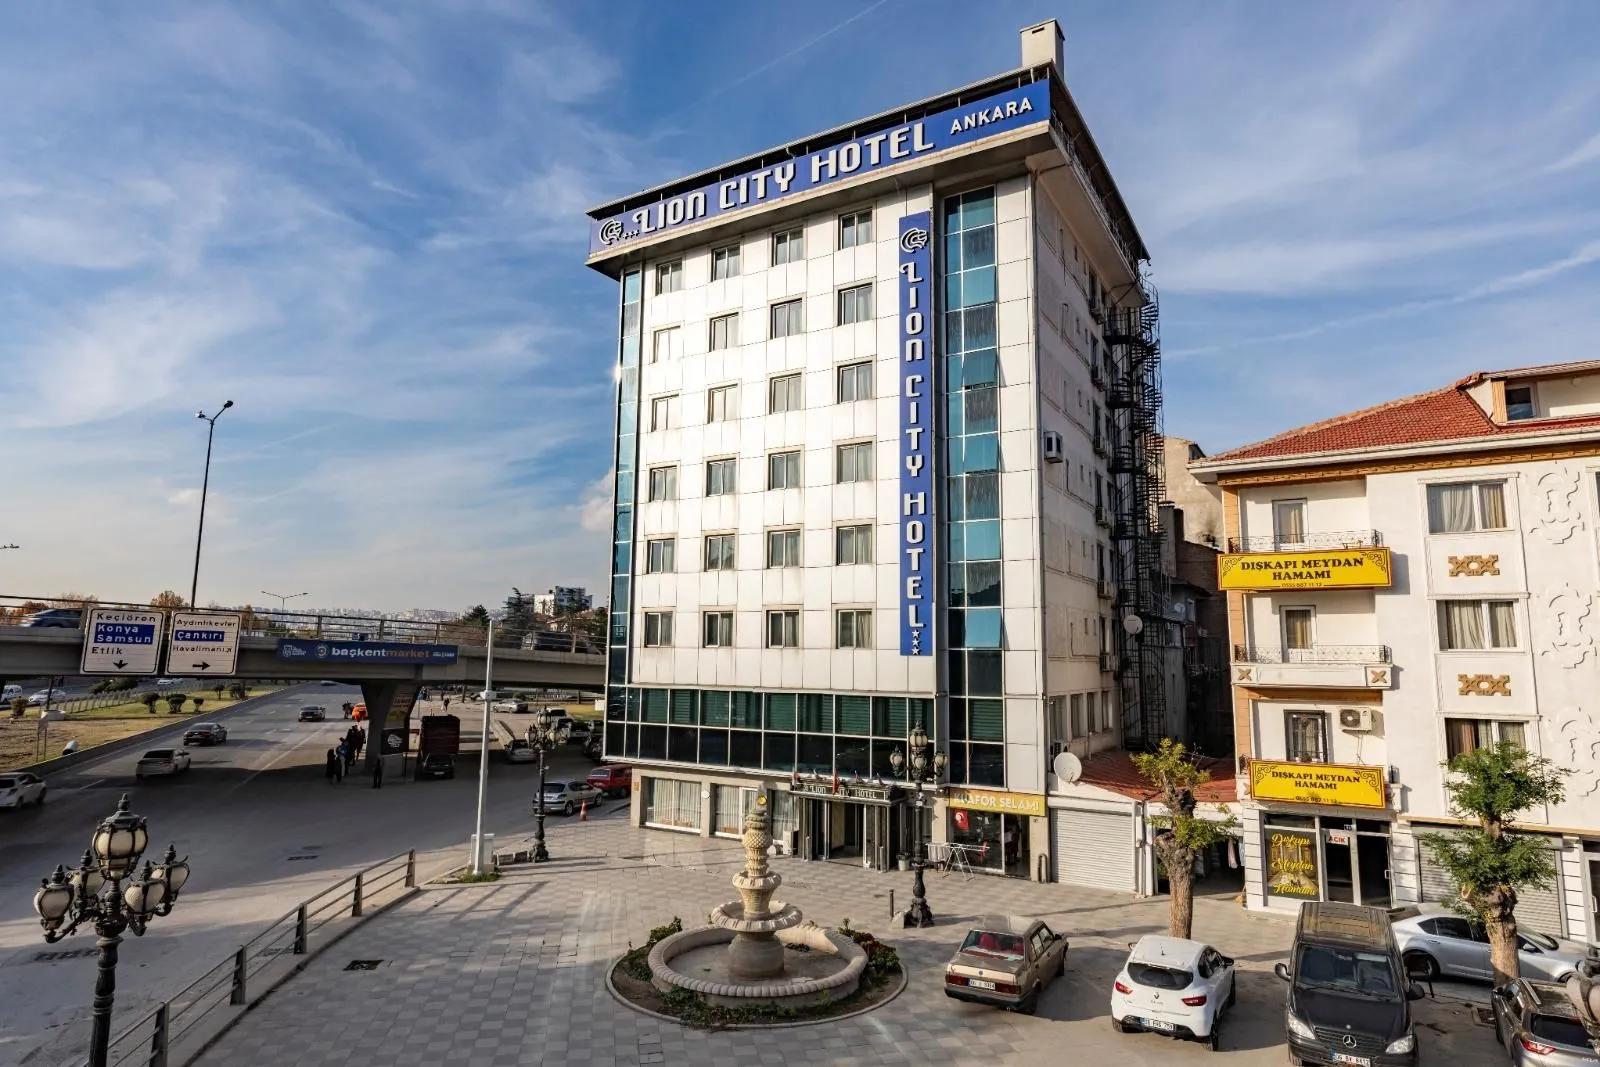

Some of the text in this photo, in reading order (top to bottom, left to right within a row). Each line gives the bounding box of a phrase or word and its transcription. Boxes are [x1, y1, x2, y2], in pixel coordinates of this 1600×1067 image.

[632, 97, 1033, 234] LION CITY HOTEL ANKARA
[899, 261, 925, 628] LION CITY HOTEL
[1241, 557, 1364, 572] DIŞKAPI MEYDAN
[1272, 570, 1332, 581] HAMAMI
[96, 612, 156, 623] Keçiören
[176, 619, 237, 628] Aydınlıkevler
[97, 624, 139, 634] Konya
[96, 634, 152, 643] Samsun
[177, 631, 224, 641] Çankırı
[91, 646, 124, 655] Etlik
[1315, 773, 1360, 783] MEYDAN
[1294, 780, 1338, 790] HAMAMI
[855, 789, 877, 799] HOTEL
[1271, 857, 1315, 871] Meydan
